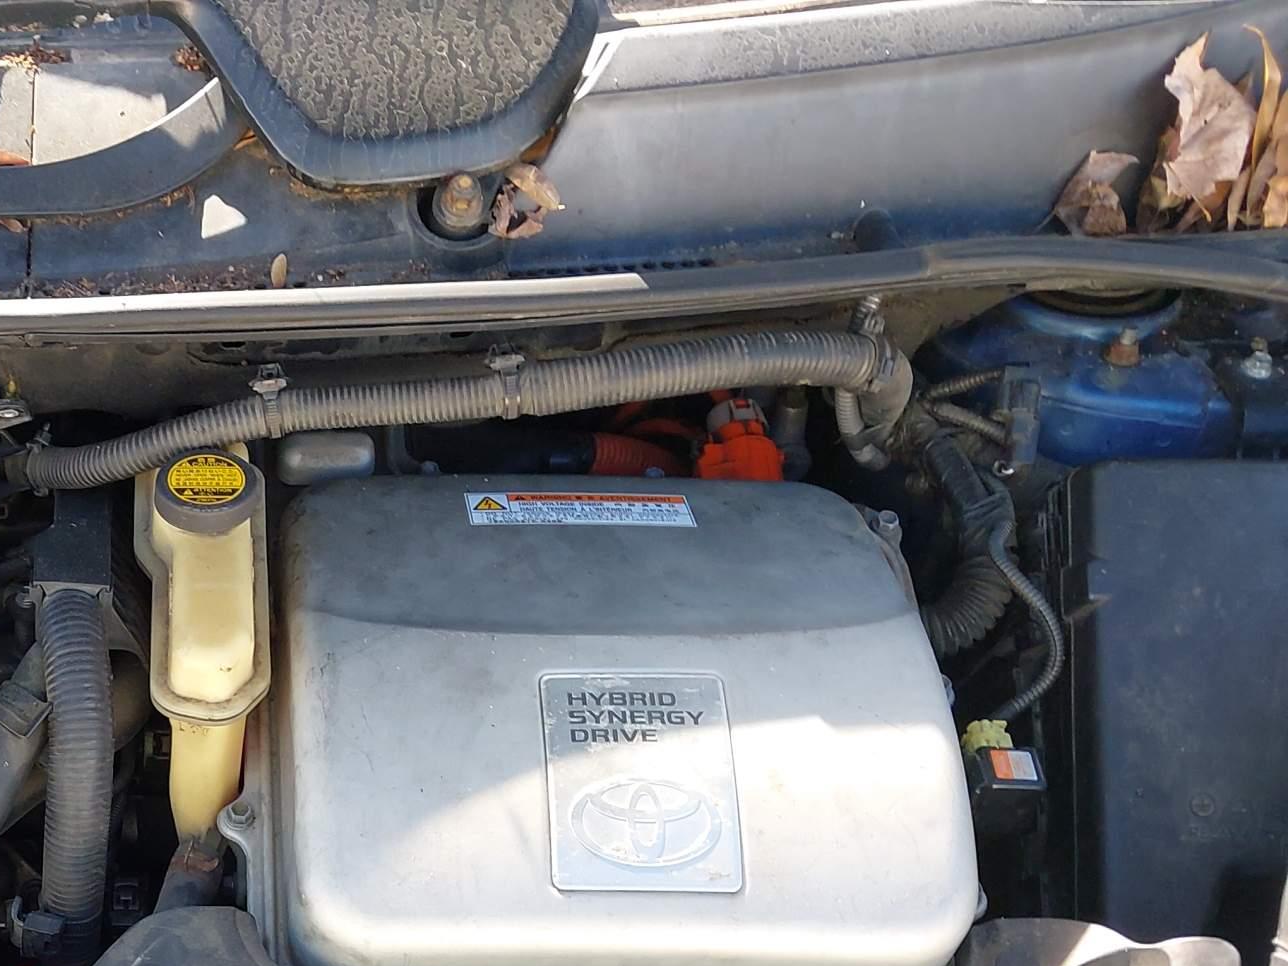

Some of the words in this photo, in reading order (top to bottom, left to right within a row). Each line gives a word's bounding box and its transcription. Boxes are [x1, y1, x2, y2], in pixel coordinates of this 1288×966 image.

[567, 692, 677, 706] HYBRID
[568, 710, 705, 725] SYNERGY
[570, 728, 659, 743] DRIVE
